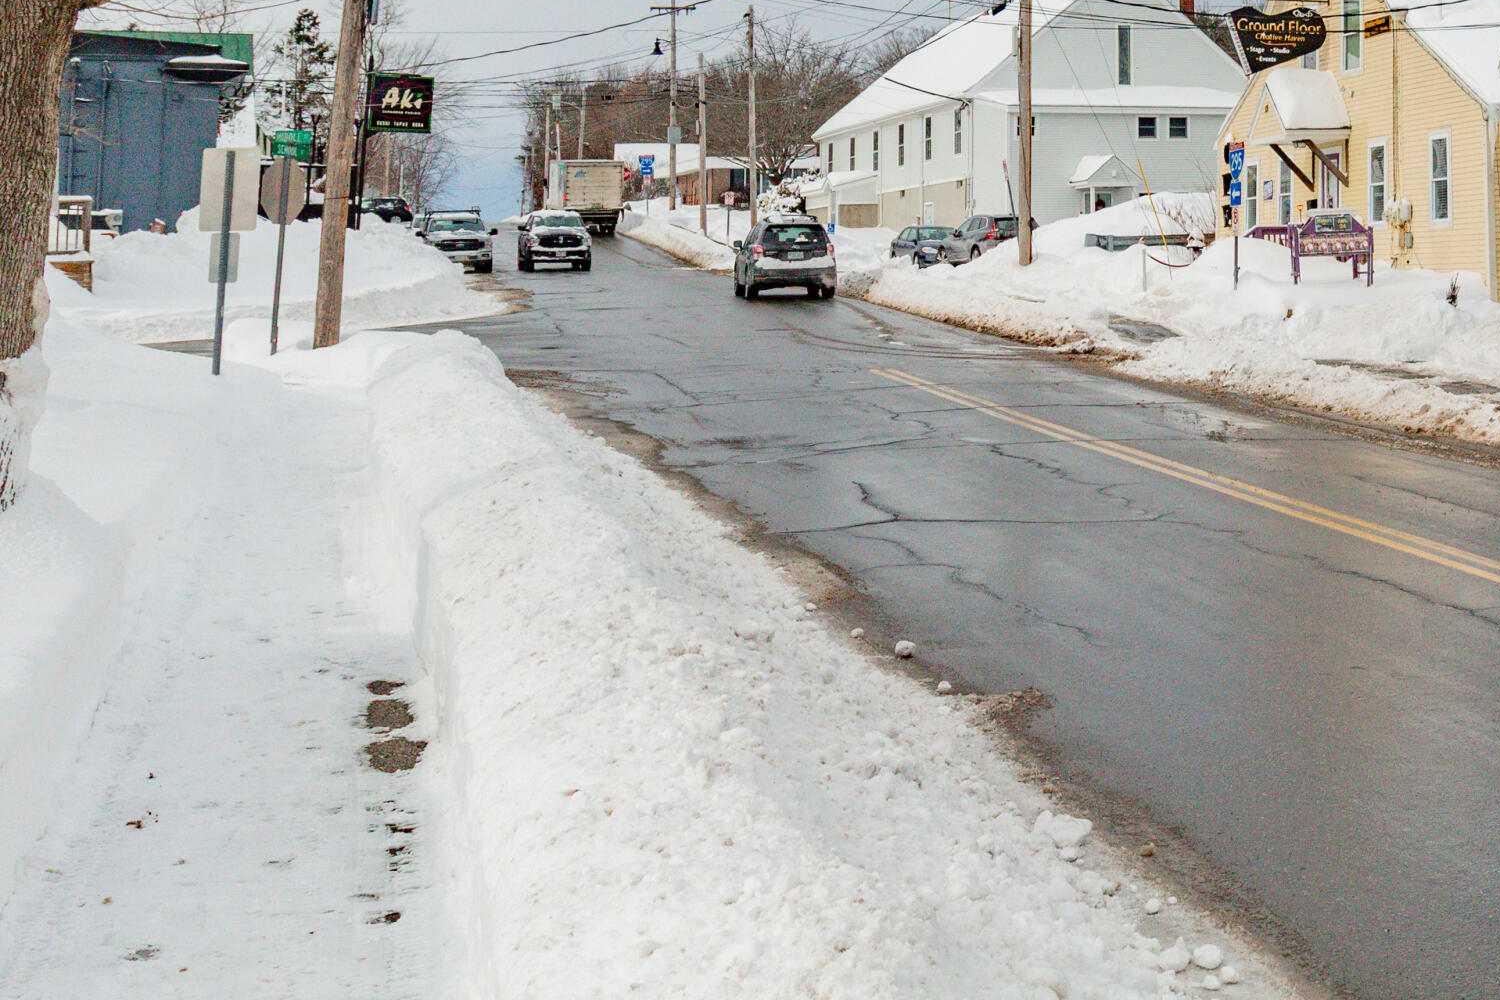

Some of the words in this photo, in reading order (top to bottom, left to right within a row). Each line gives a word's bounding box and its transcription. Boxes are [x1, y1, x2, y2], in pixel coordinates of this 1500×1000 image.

[1236, 17, 1285, 32] Ground
[1288, 20, 1321, 35] Floor
[1255, 32, 1283, 41] Creative
[1284, 34, 1306, 43] Haven
[381, 86, 423, 110] Aki
[641, 157, 653, 165] 295
[1231, 151, 1243, 172] 295
